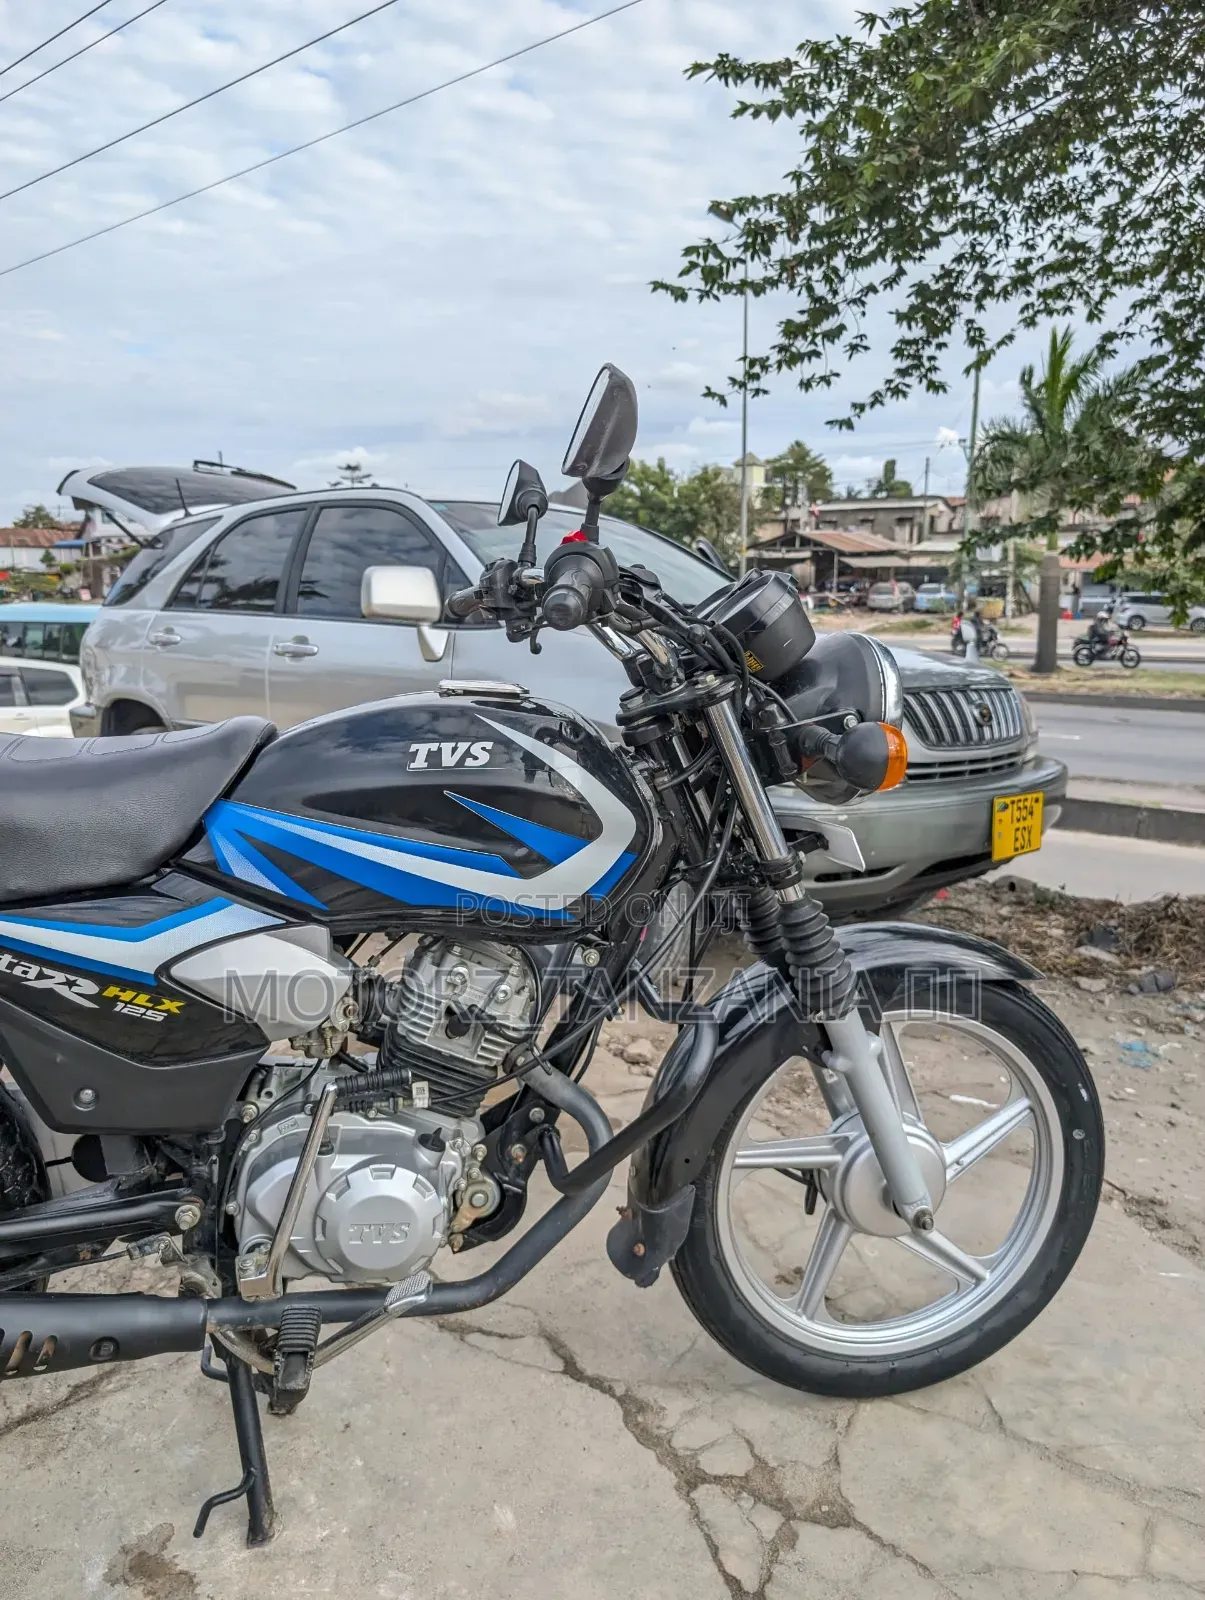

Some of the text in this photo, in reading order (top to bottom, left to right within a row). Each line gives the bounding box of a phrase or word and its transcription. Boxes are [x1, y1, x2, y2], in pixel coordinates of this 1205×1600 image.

[408, 741, 494, 769] TVS
[1010, 796, 1034, 825] T554
[1013, 824, 1033, 852] ESX
[101, 985, 186, 1014] HLX
[113, 1001, 168, 1022] 125
[348, 1222, 411, 1244] TVS
